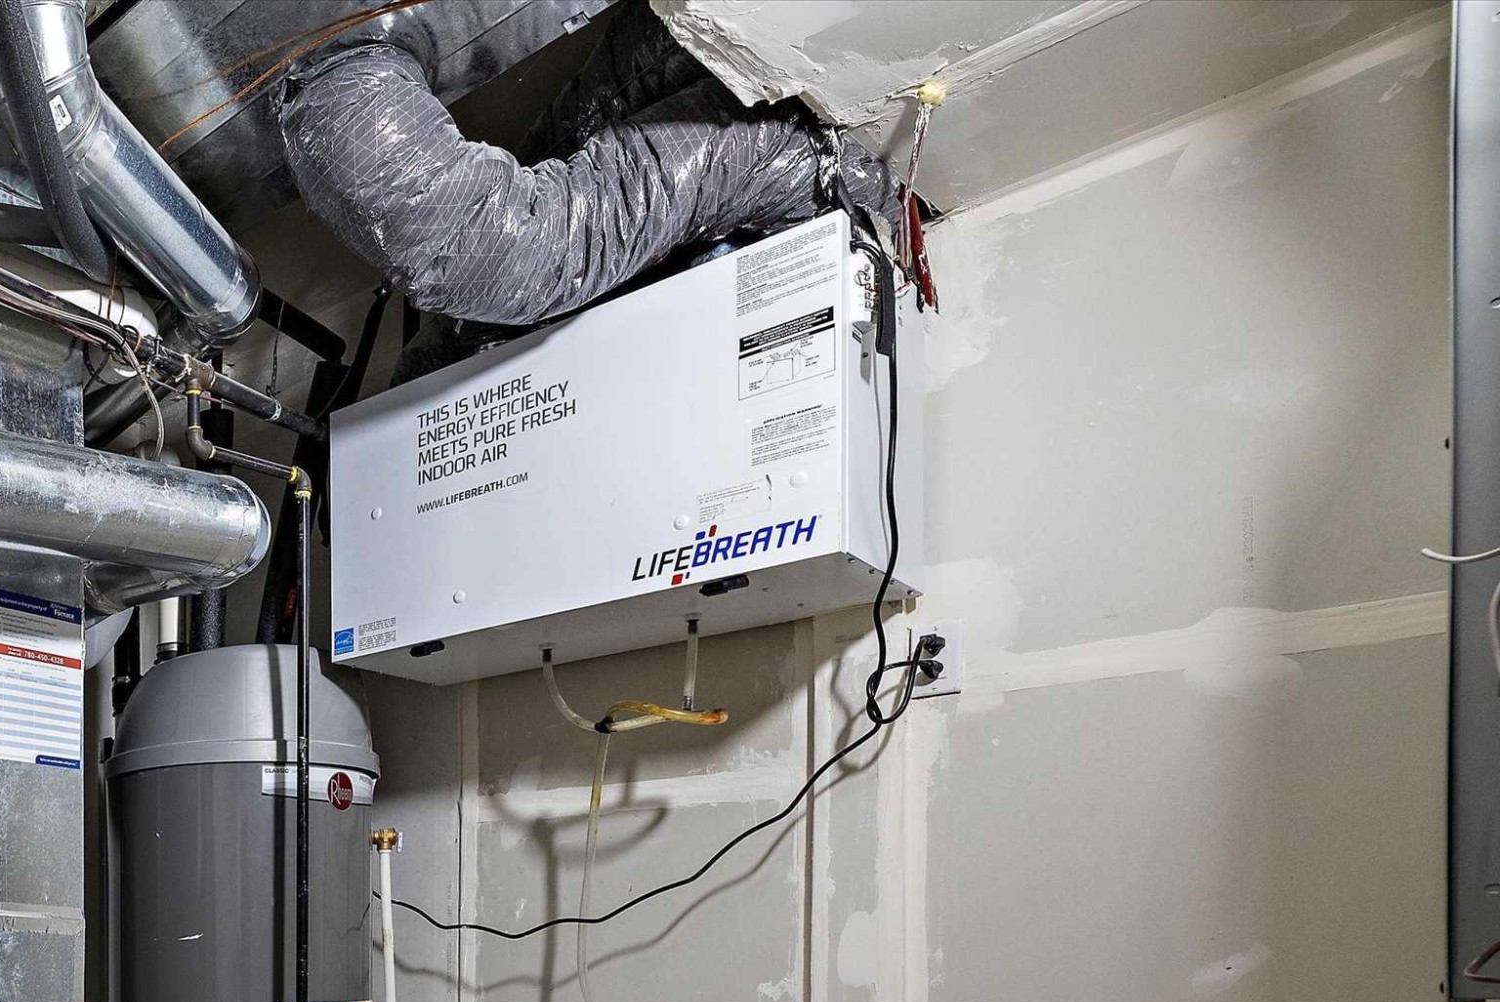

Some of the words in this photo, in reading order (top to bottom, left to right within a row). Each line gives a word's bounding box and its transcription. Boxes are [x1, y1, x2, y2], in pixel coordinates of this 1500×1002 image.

[417, 405, 449, 428] THIS
[455, 398, 468, 416] IS
[473, 374, 531, 408] WHERE
[418, 414, 476, 448] ENERGY
[481, 381, 569, 426] EFFICIENCY
[418, 437, 468, 466] MEETS
[474, 420, 516, 448] PURE
[522, 399, 576, 431] FRESH
[418, 454, 476, 485] INDOOR
[481, 443, 507, 465] AIR
[417, 472, 528, 514] WWW.LIFEBREATH.COM
[632, 515, 818, 582] LIFEBREATH
[330, 773, 352, 805] Rheem
